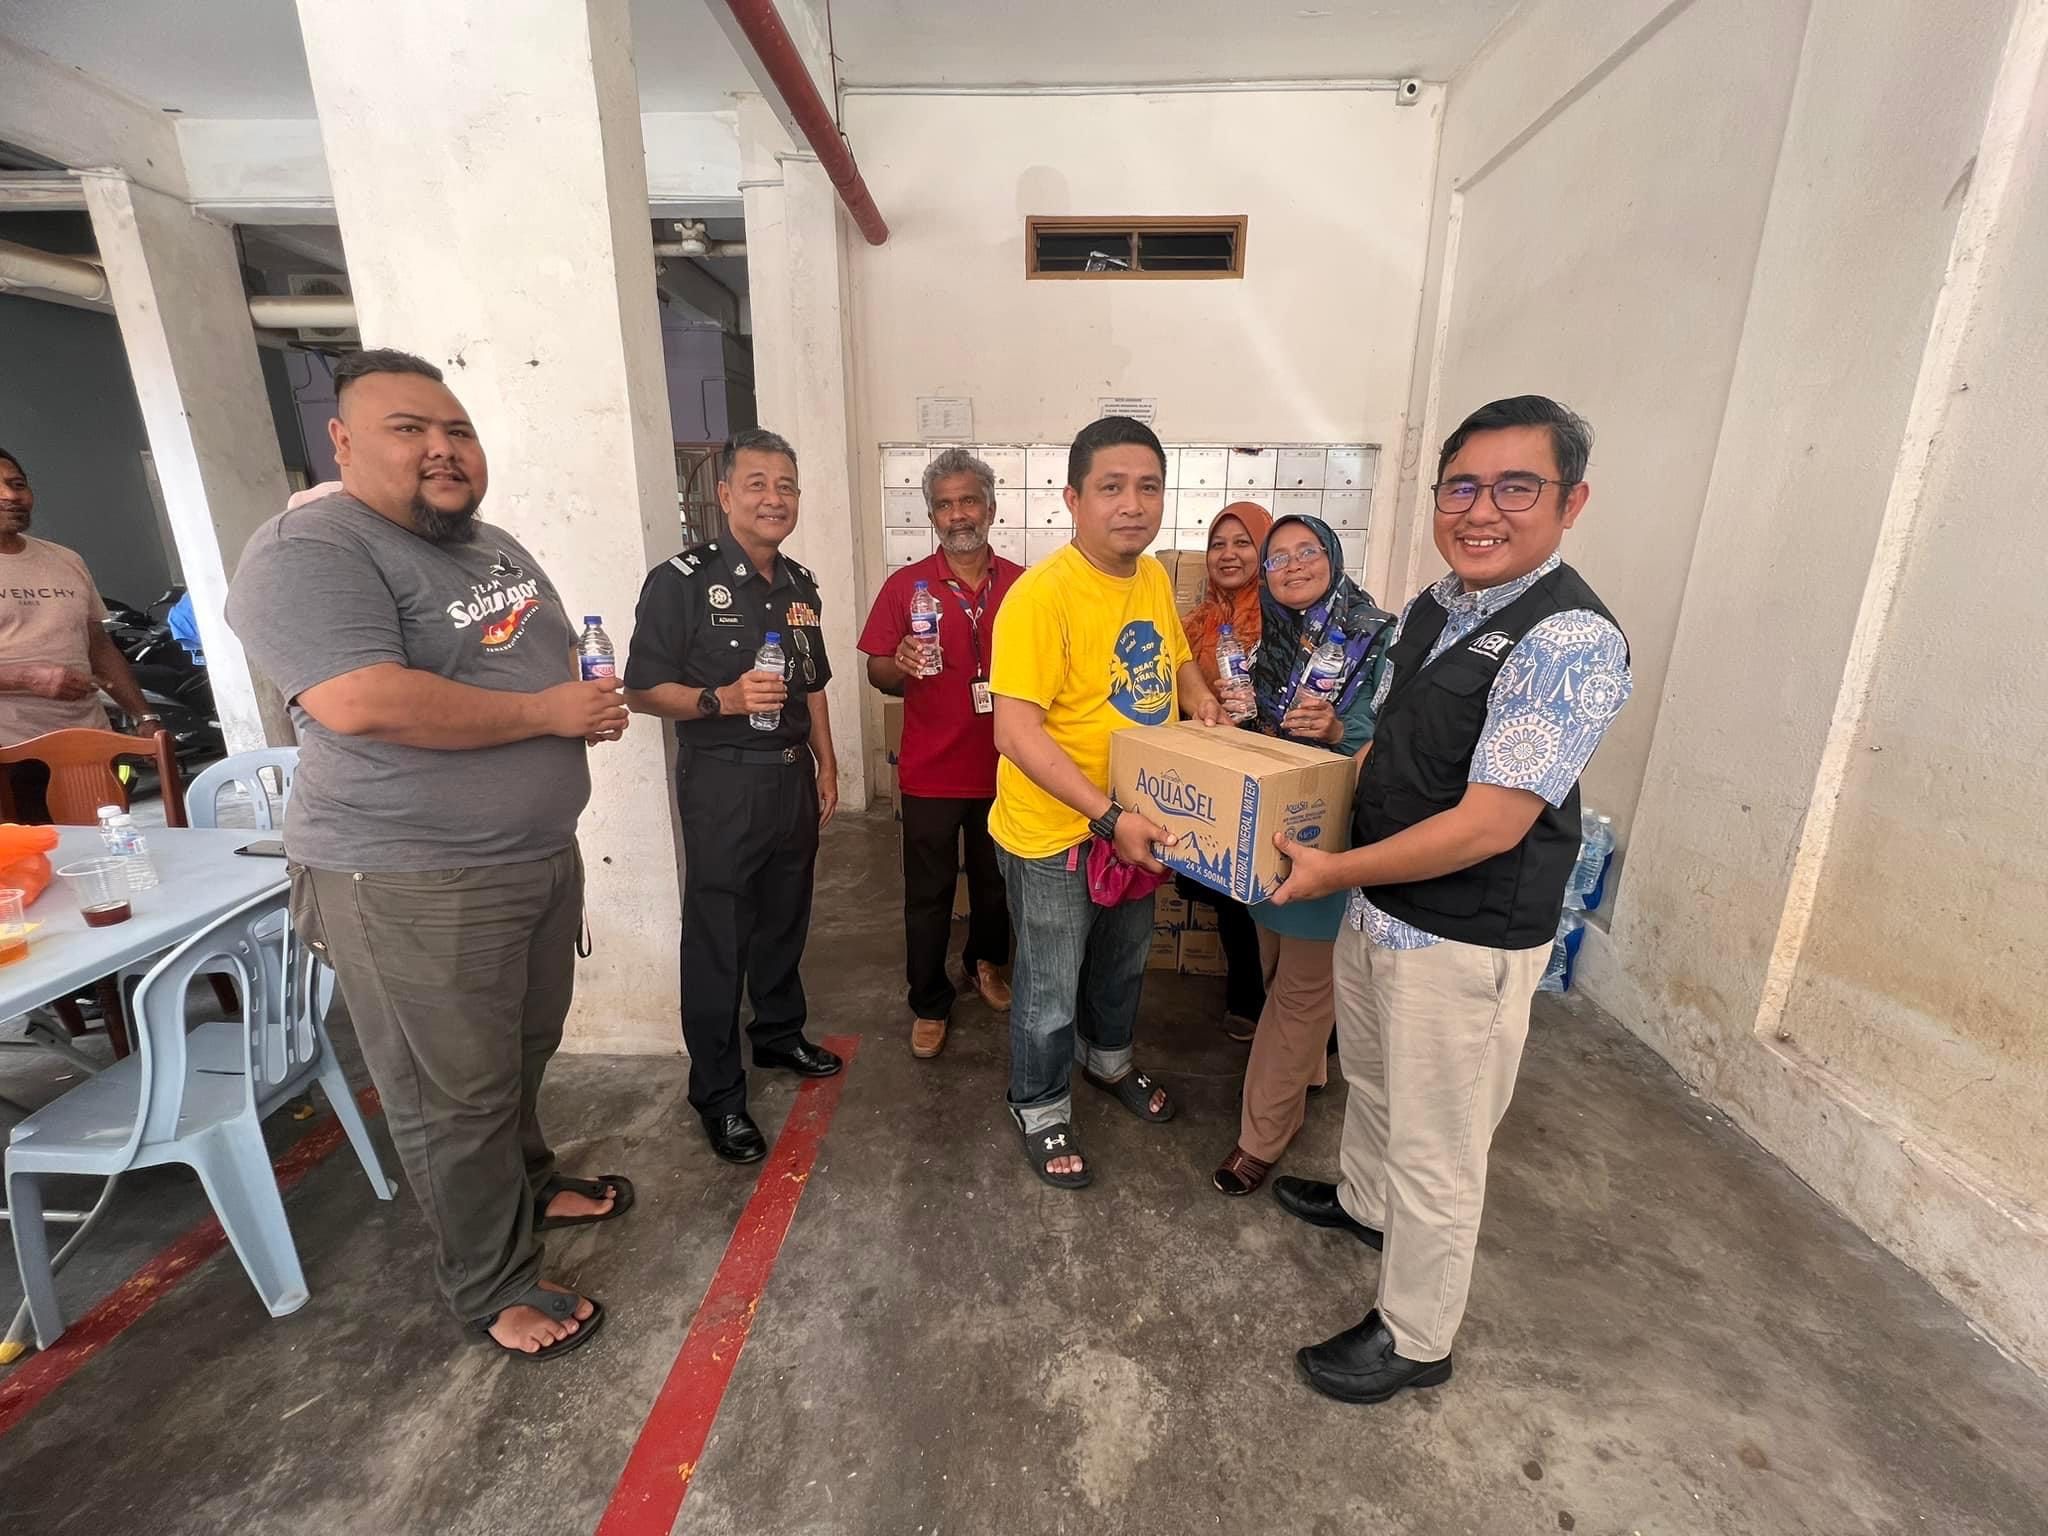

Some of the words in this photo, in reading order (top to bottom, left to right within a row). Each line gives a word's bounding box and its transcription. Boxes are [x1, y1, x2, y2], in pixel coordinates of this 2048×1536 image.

[1135, 767, 1217, 822] AQUASEL
[1242, 781, 1256, 815] WATER
[1239, 815, 1252, 855] MINERAL
[1185, 860, 1195, 870] 24
[1203, 869, 1228, 888] 500ML
[1235, 855, 1249, 895] NATURAL
